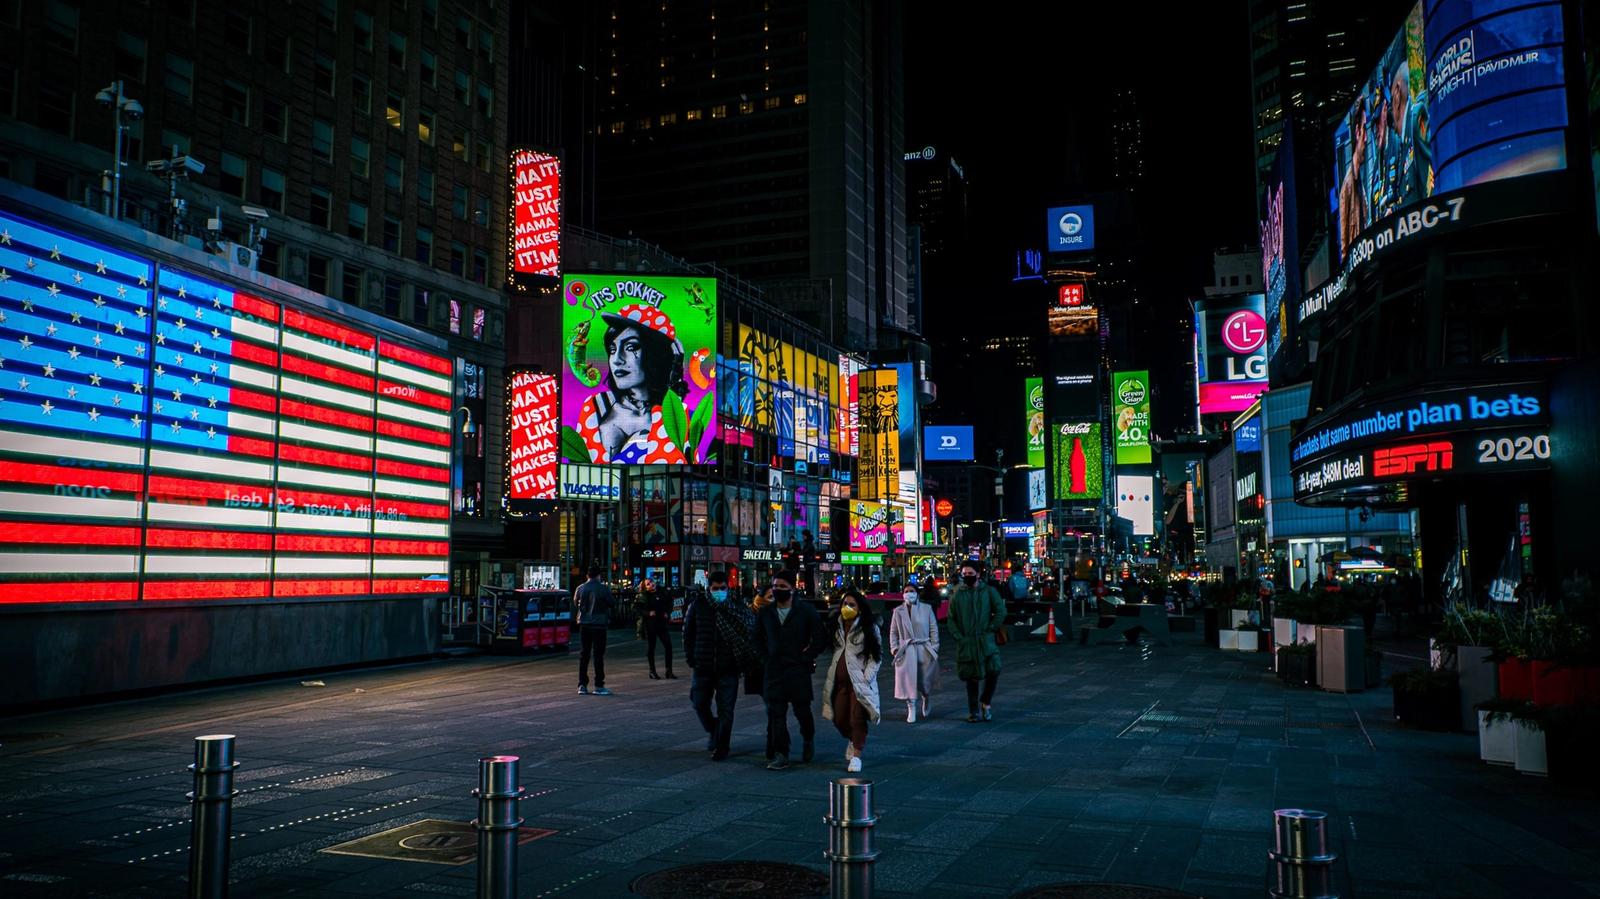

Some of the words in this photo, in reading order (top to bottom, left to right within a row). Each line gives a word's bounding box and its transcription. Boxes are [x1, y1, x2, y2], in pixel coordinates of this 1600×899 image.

[1436, 37, 1472, 73] WORLD
[1476, 58, 1509, 77] DAVID
[1509, 51, 1539, 68] MUIR
[1439, 52, 1473, 87] NEWS
[516, 184, 552, 206] JUST
[515, 217, 556, 236] MAMA
[515, 230, 559, 251] MAKES
[1060, 235, 1083, 245] INSURE
[518, 250, 540, 267] IT!
[1305, 293, 1323, 317] Muir
[1353, 238, 1374, 268] 6:30p
[1376, 227, 1393, 250] on
[1396, 197, 1465, 241] ABC-7
[590, 287, 617, 310] IT'S
[616, 280, 667, 309] POKKET
[1227, 355, 1266, 381] LG
[1122, 389, 1144, 398] Green
[511, 404, 550, 430] JUST
[1126, 412, 1148, 420] MADE
[1299, 434, 1320, 459] brackets
[1319, 429, 1330, 449] but
[1330, 424, 1350, 446] same
[1352, 411, 1404, 438] number
[1407, 402, 1462, 432] plan
[1469, 394, 1540, 419] bets
[1118, 427, 1149, 442] 40%
[511, 438, 553, 461] MAMA
[1322, 460, 1342, 487] $48M
[1342, 455, 1364, 480] deal
[1373, 440, 1453, 477] ESPN
[1478, 435, 1551, 463] 2020
[511, 451, 557, 476] MAKES
[514, 474, 537, 493] IT!
